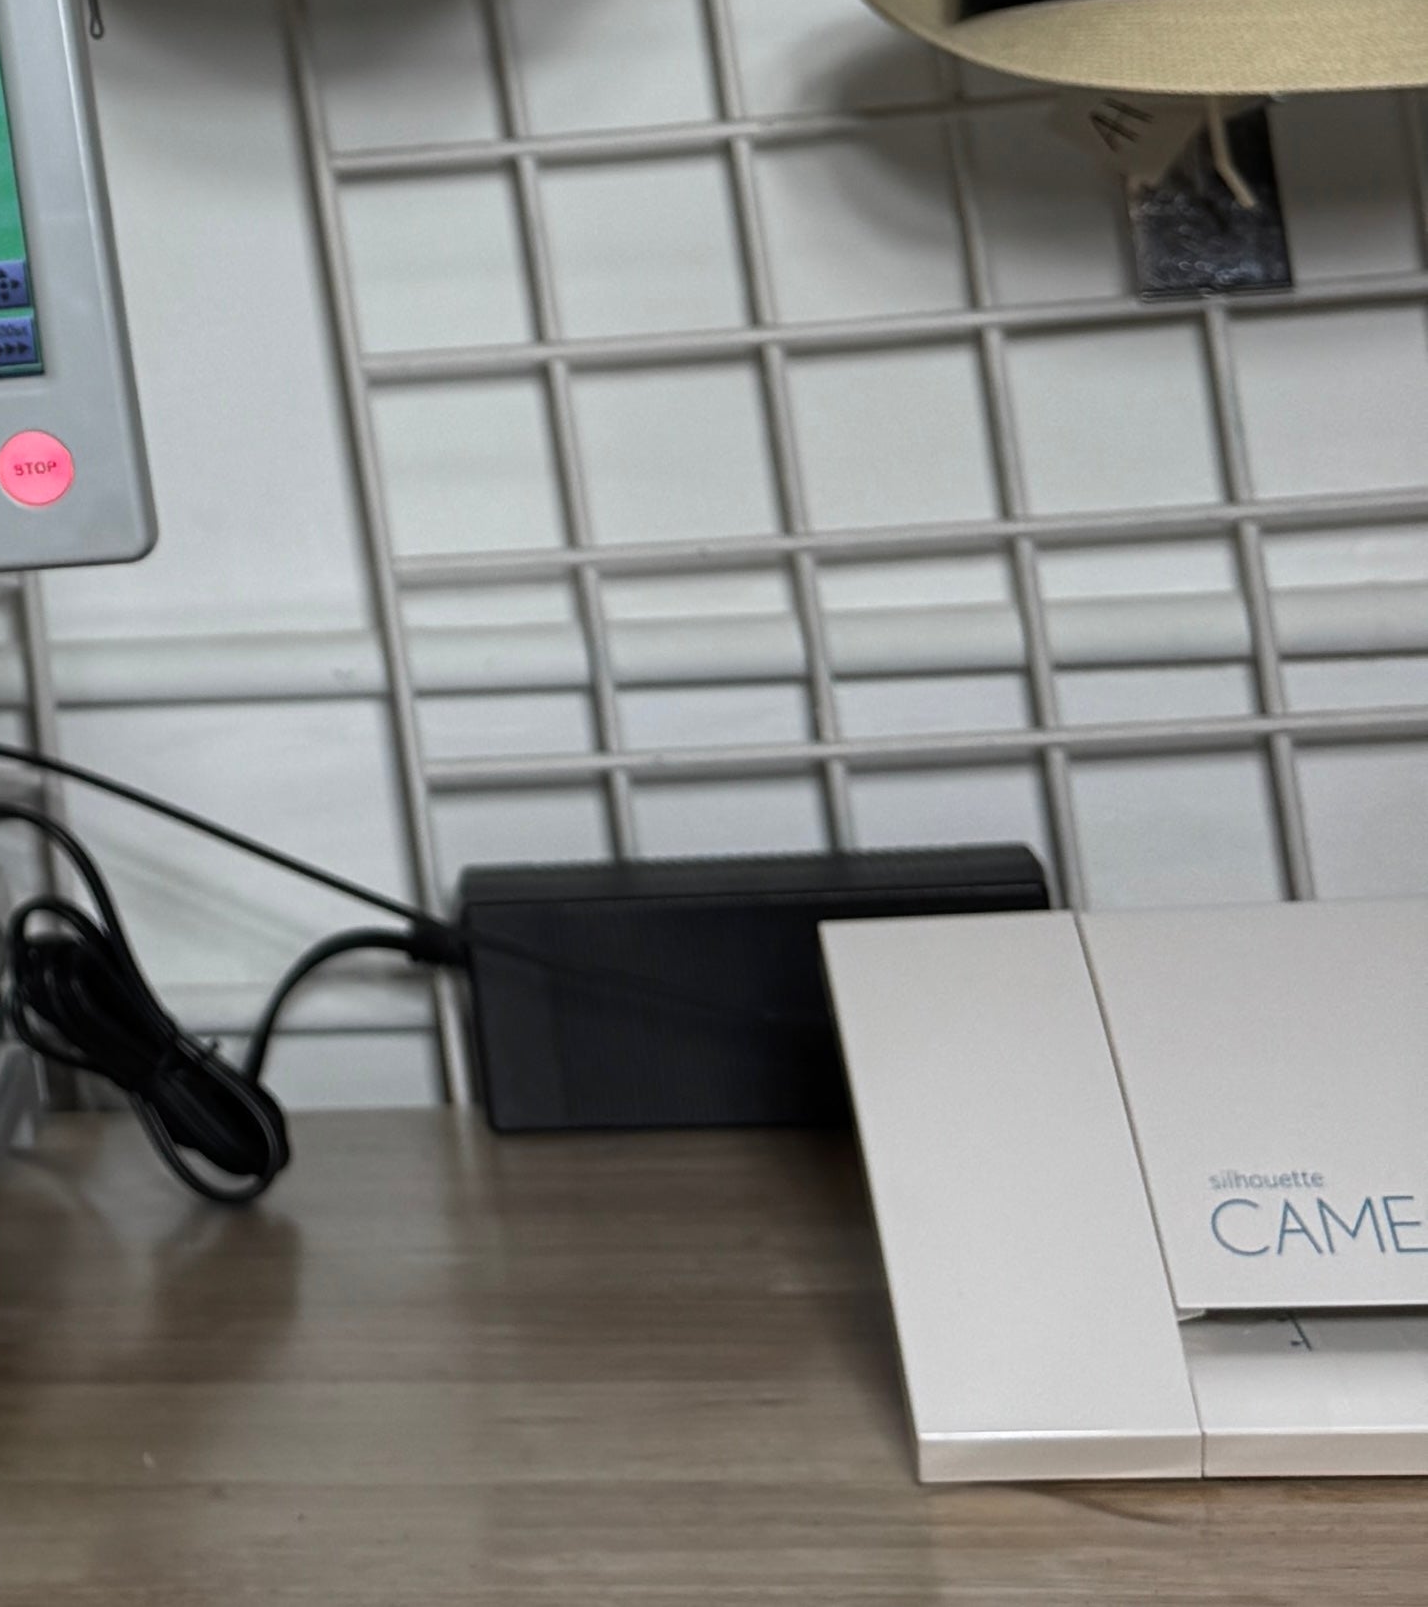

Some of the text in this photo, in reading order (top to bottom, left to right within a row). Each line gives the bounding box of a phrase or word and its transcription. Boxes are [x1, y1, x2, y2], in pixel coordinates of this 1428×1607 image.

[13, 460, 58, 477] STOP
[1209, 1169, 1326, 1190] silhouette
[1210, 1195, 1428, 1257] CAME
